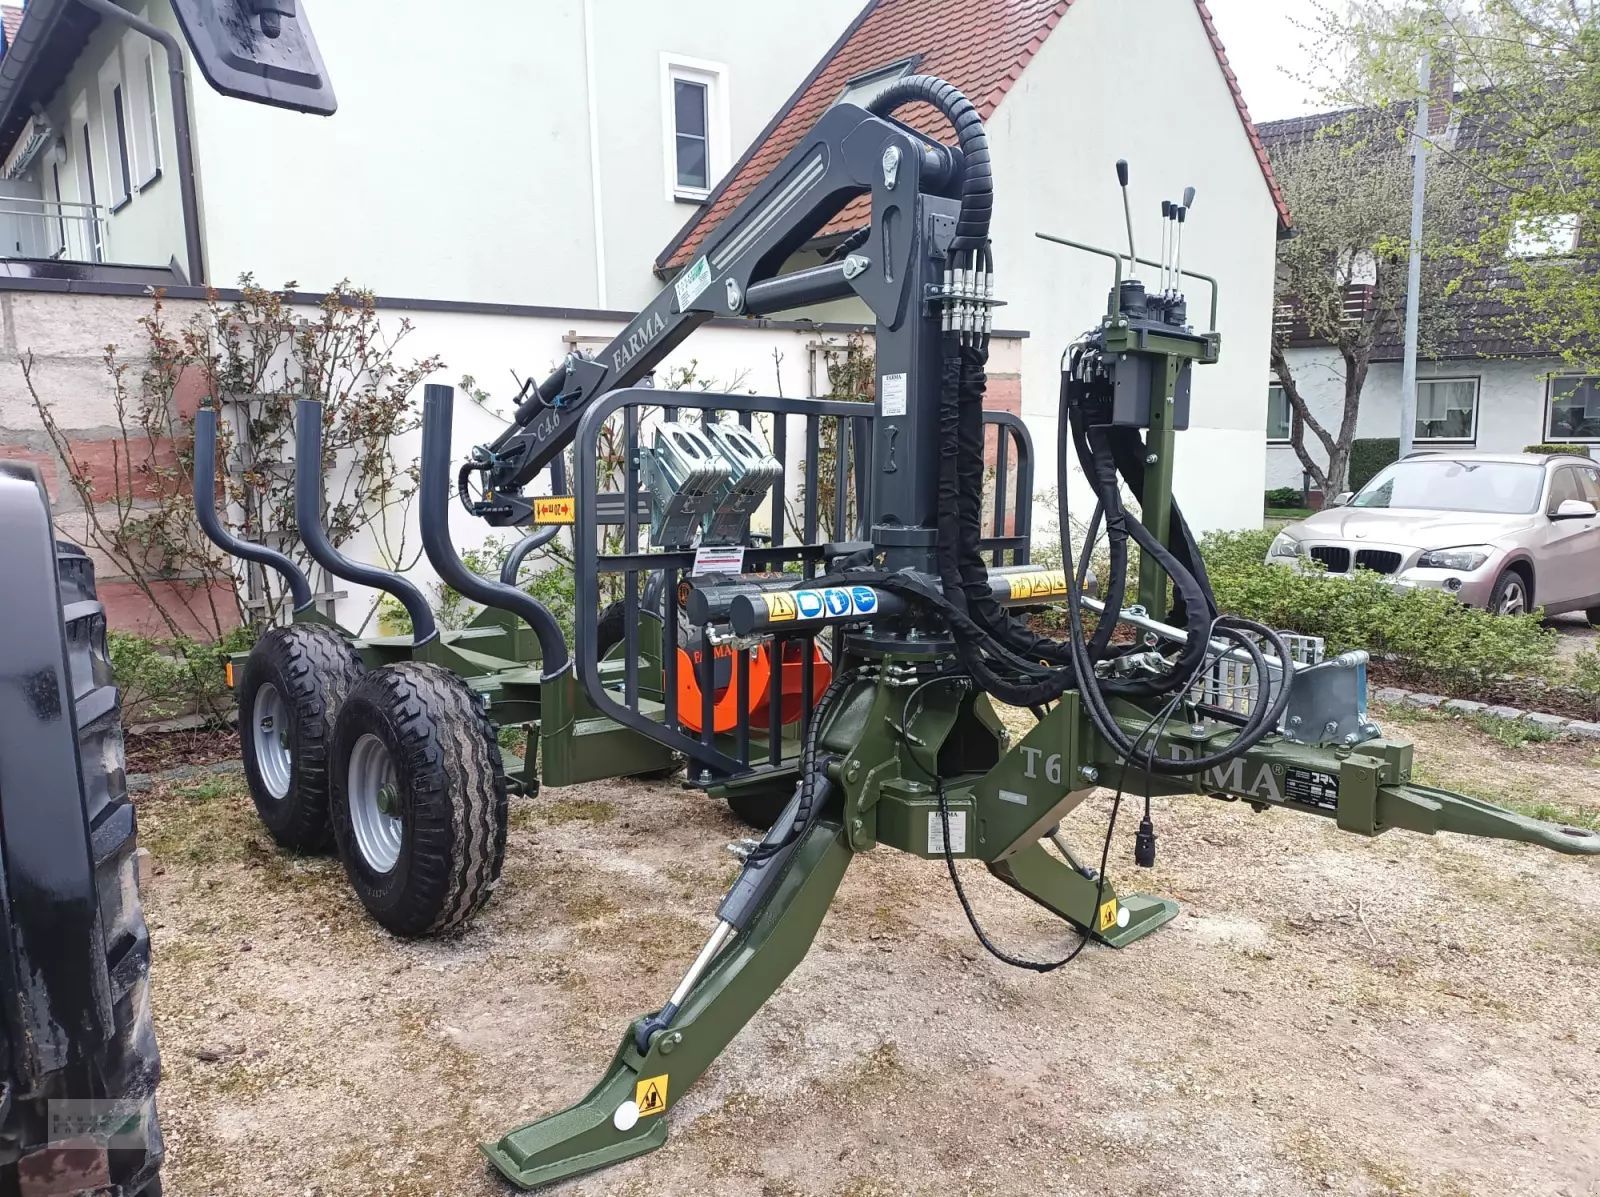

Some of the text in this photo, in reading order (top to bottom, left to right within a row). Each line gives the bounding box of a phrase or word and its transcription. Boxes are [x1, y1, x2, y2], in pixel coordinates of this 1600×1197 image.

[612, 312, 665, 374] FARMA
[537, 408, 560, 442] C4.6
[694, 644, 732, 664] FMA
[1020, 745, 1062, 785] T6
